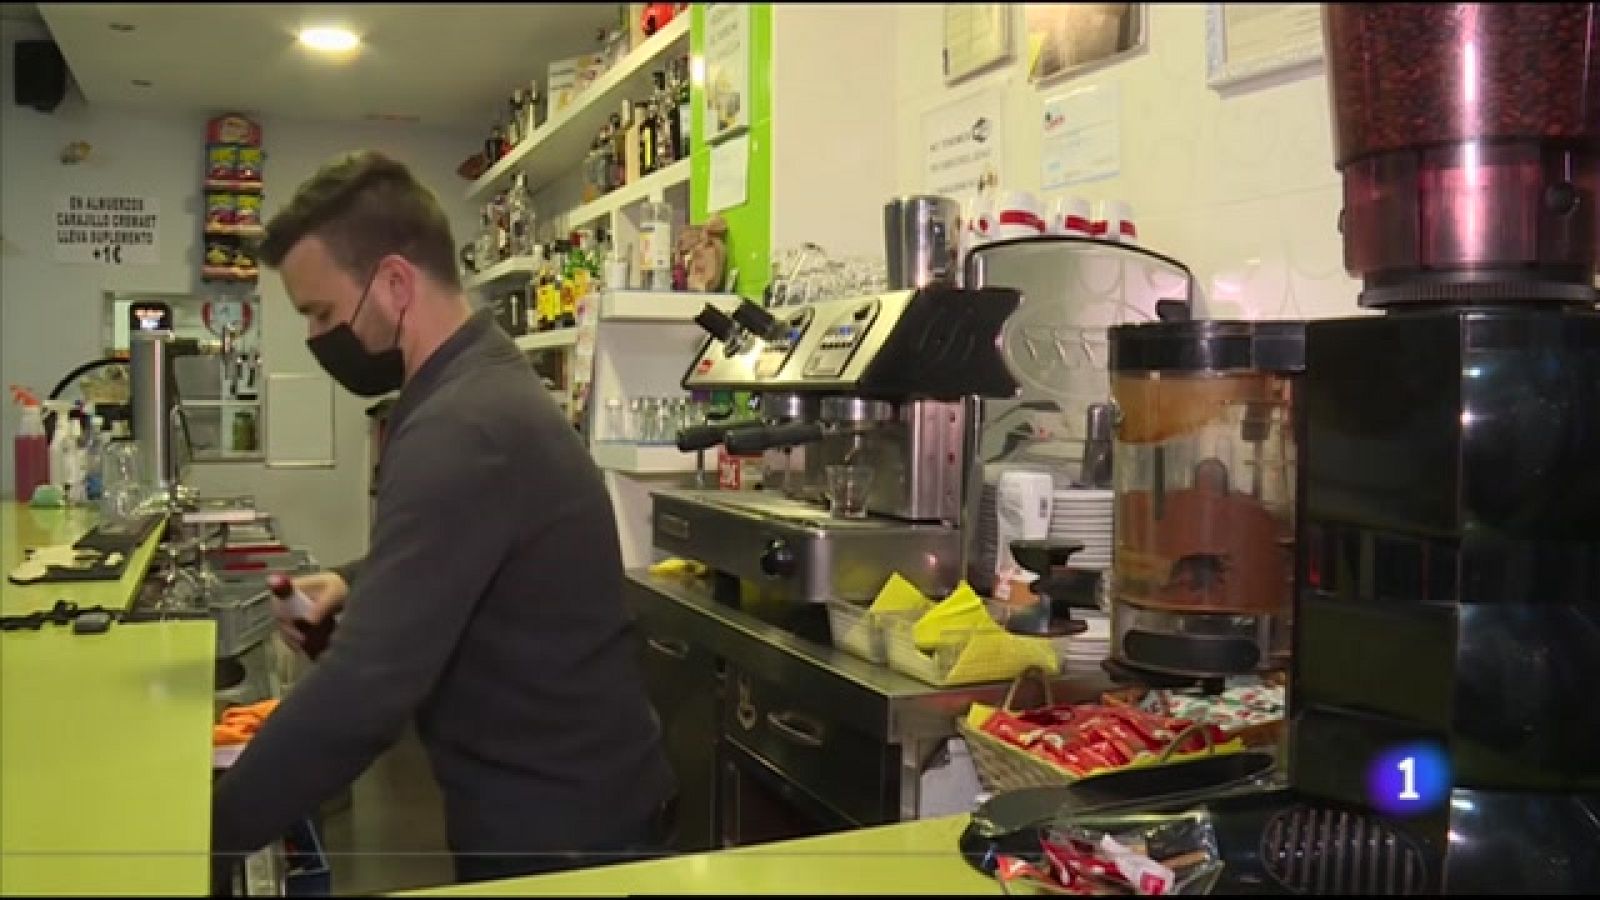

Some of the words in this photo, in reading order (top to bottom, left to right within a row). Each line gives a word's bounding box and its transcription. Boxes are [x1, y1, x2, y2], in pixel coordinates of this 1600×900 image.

[87, 197, 144, 211] ALMUERZOS
[57, 212, 110, 227] CARAJILLO
[57, 229, 88, 244] LLEVA
[90, 230, 153, 245] SUPLEMENTO
[93, 245, 122, 265] +1€
